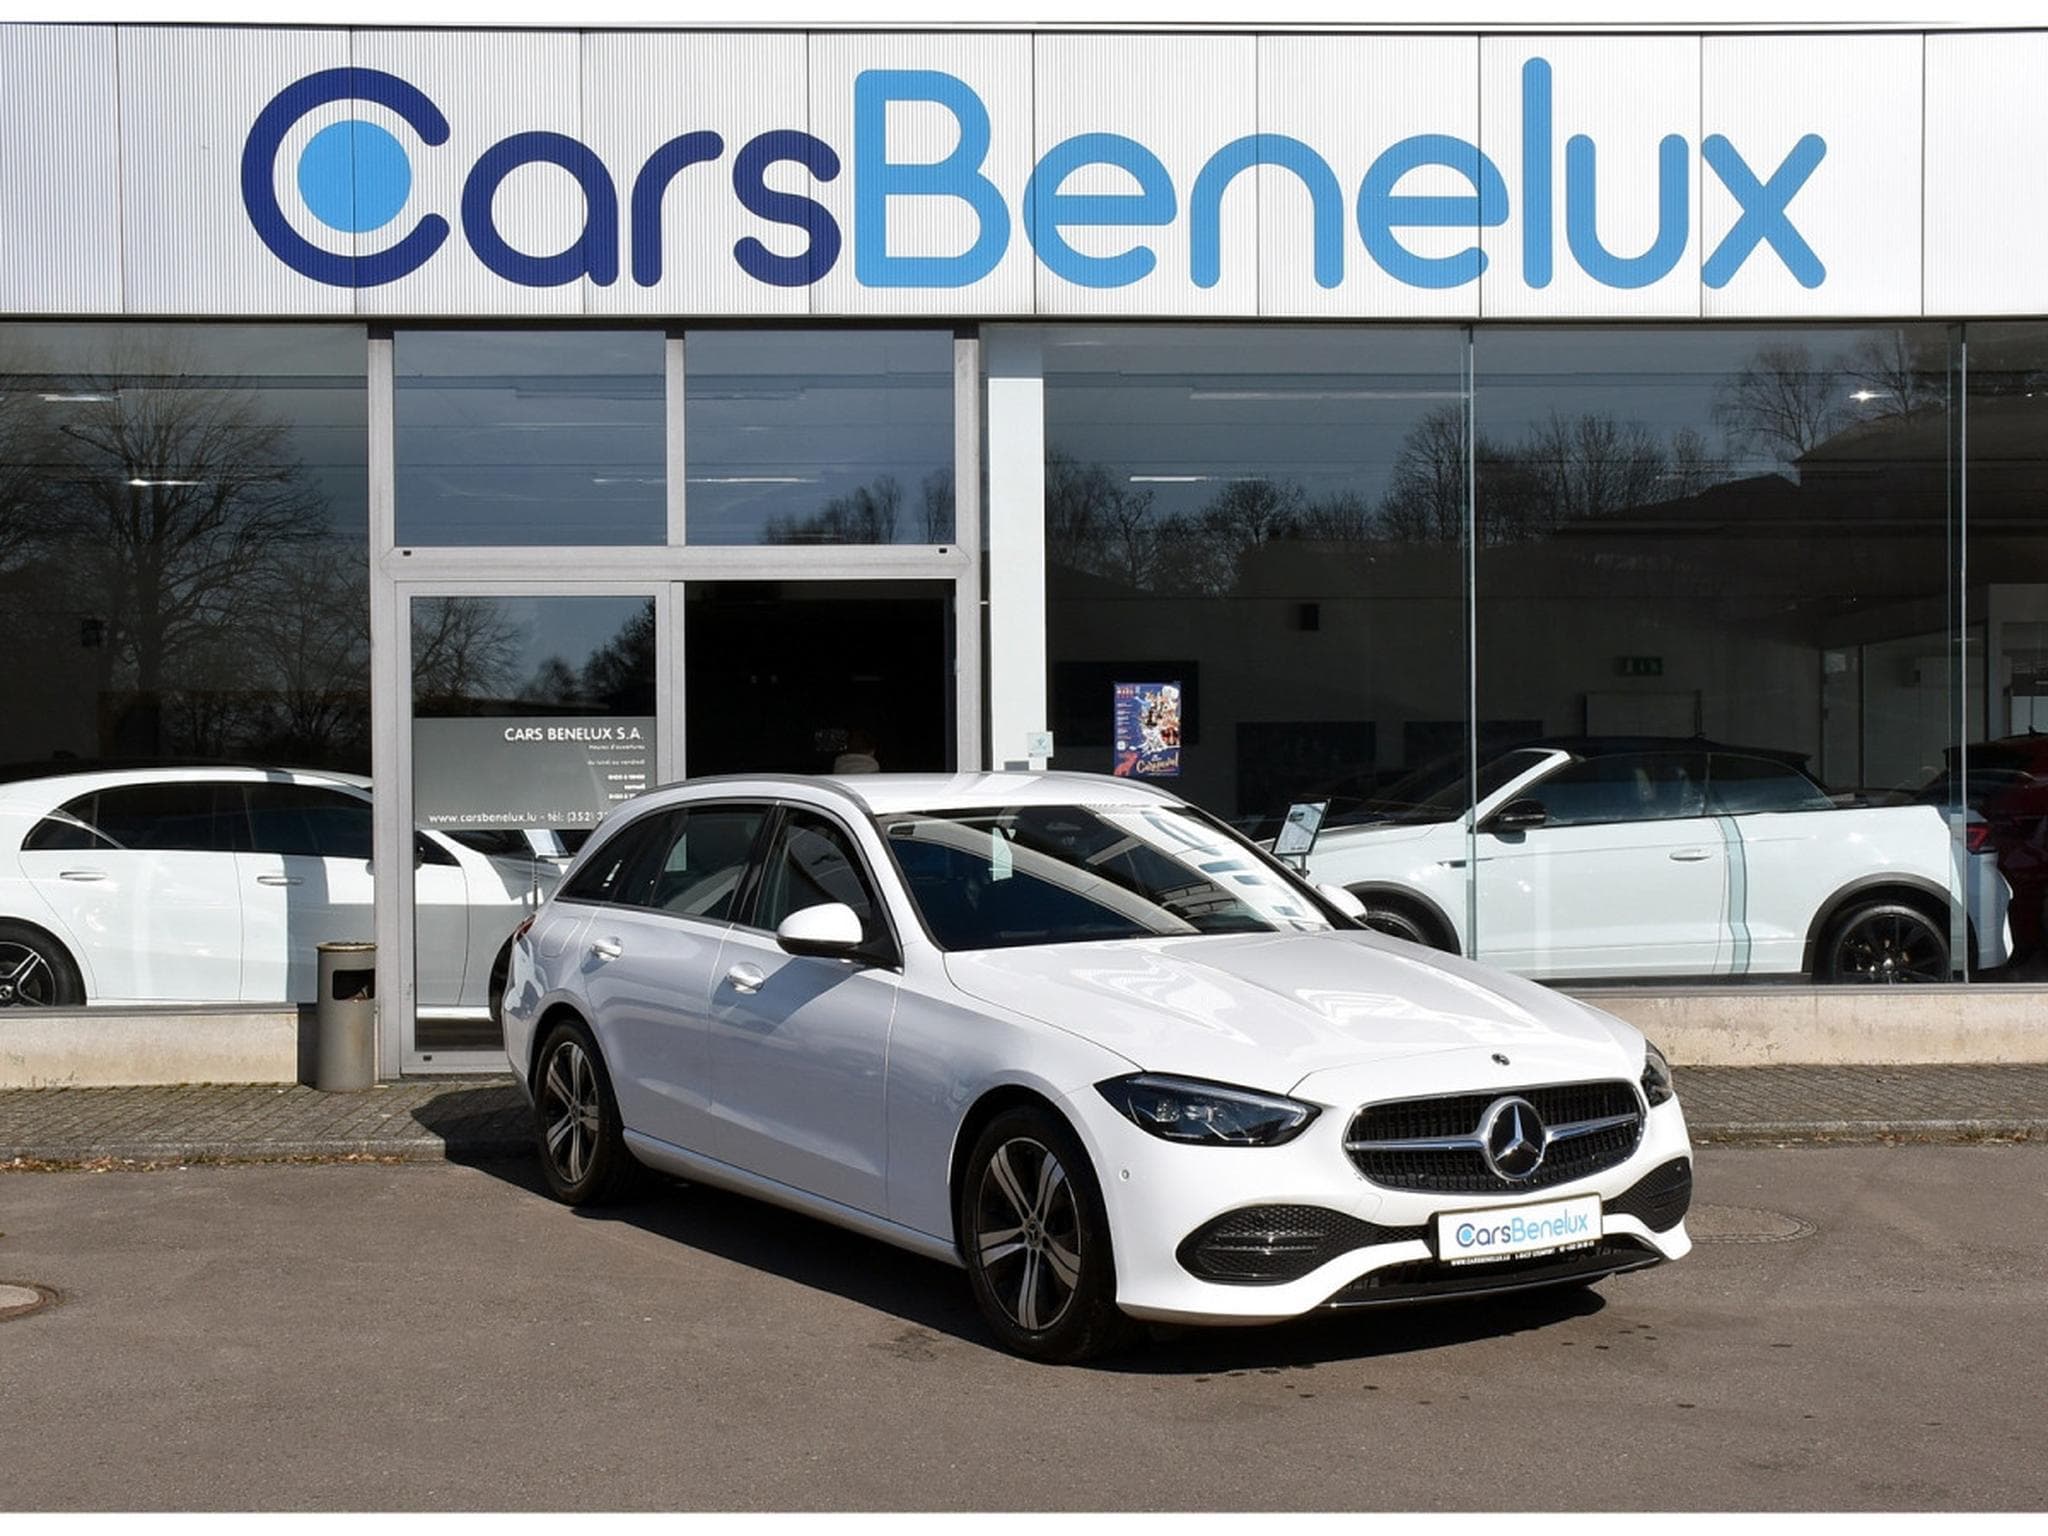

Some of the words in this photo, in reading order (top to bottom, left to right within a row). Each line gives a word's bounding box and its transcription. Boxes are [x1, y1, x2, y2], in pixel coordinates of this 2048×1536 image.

[241, 57, 1827, 289] CarsBenelux
[504, 727, 543, 741] CARS
[547, 727, 613, 741] BENELUX
[616, 726, 645, 741] S.A.
[428, 812, 537, 823] www.carsbenelux.lu
[1456, 1209, 1588, 1248] CarsBenelux
